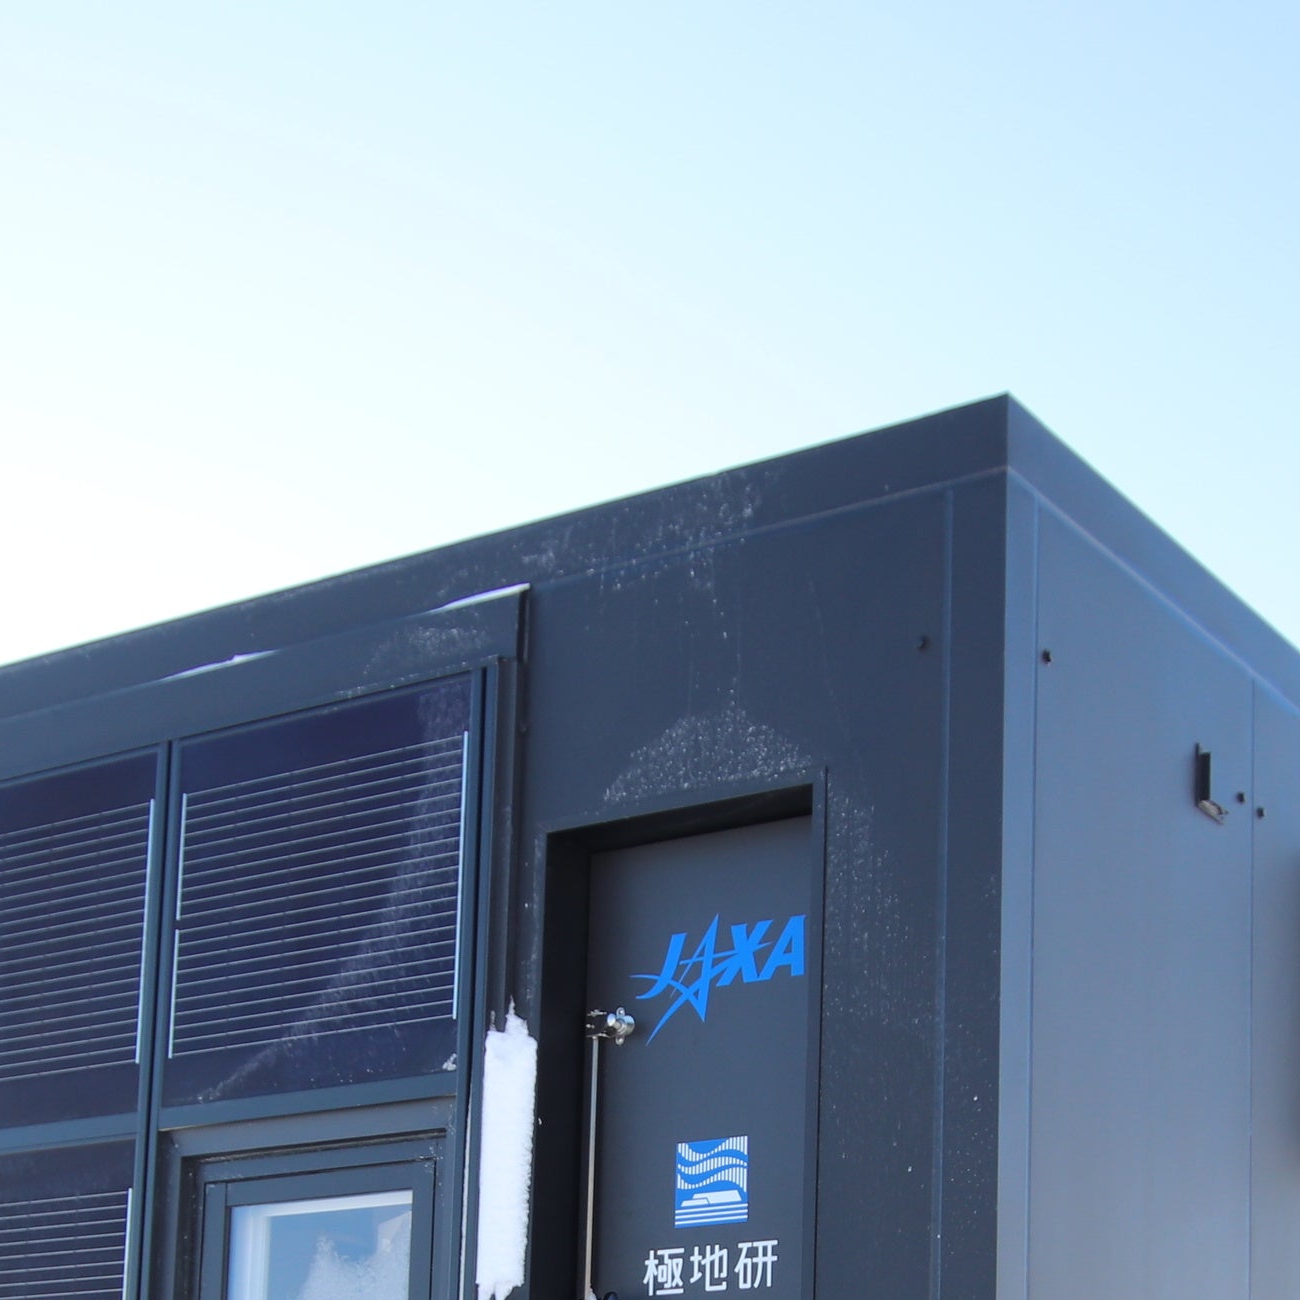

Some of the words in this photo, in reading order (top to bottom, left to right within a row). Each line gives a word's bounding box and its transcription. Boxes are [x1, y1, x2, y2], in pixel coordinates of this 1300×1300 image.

[631, 913, 807, 1044] JAXA
[643, 1239, 779, 1297] 極地研
